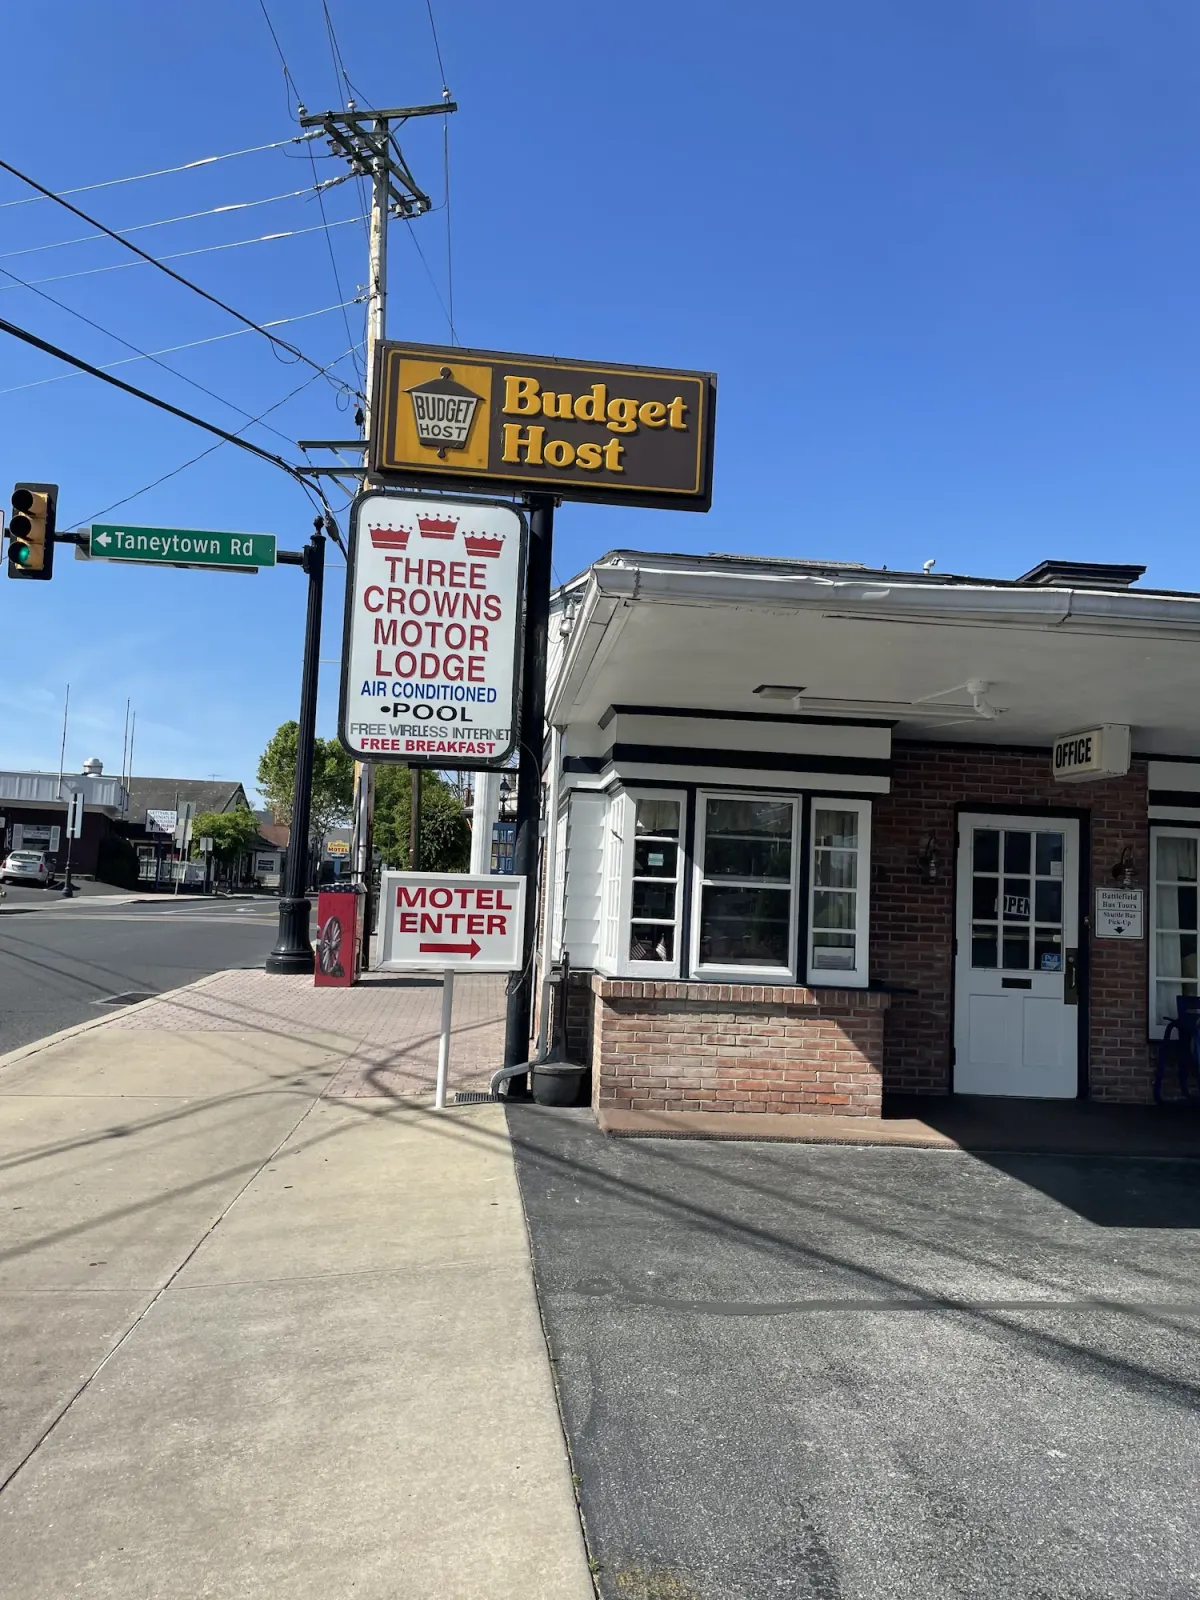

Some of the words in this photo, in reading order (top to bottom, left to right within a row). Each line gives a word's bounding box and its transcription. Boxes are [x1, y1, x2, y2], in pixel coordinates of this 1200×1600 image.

[415, 395, 474, 424] BUDGET
[502, 375, 688, 433] Budget
[420, 424, 467, 439] HOST
[501, 423, 625, 472] Host
[114, 531, 221, 556] Taneytown
[230, 538, 253, 556] Rd
[385, 556, 488, 590] THREE
[363, 585, 502, 621] CROWNS
[373, 618, 489, 651] MOTOR
[375, 650, 486, 682] LODGE
[360, 680, 387, 697] AIR
[392, 682, 497, 703] CONDITIONED
[350, 722, 387, 736] FREE
[389, 724, 448, 738] WIRELESS
[452, 727, 511, 741] INTERNET
[360, 738, 400, 751] FREE
[405, 740, 496, 754] BREAKFAST
[1055, 737, 1092, 769] OFFICE
[396, 886, 512, 910] MOTEL
[1101, 892, 1138, 900] Battlefield
[1117, 901, 1137, 909] Tours
[400, 912, 507, 935] ENTER
